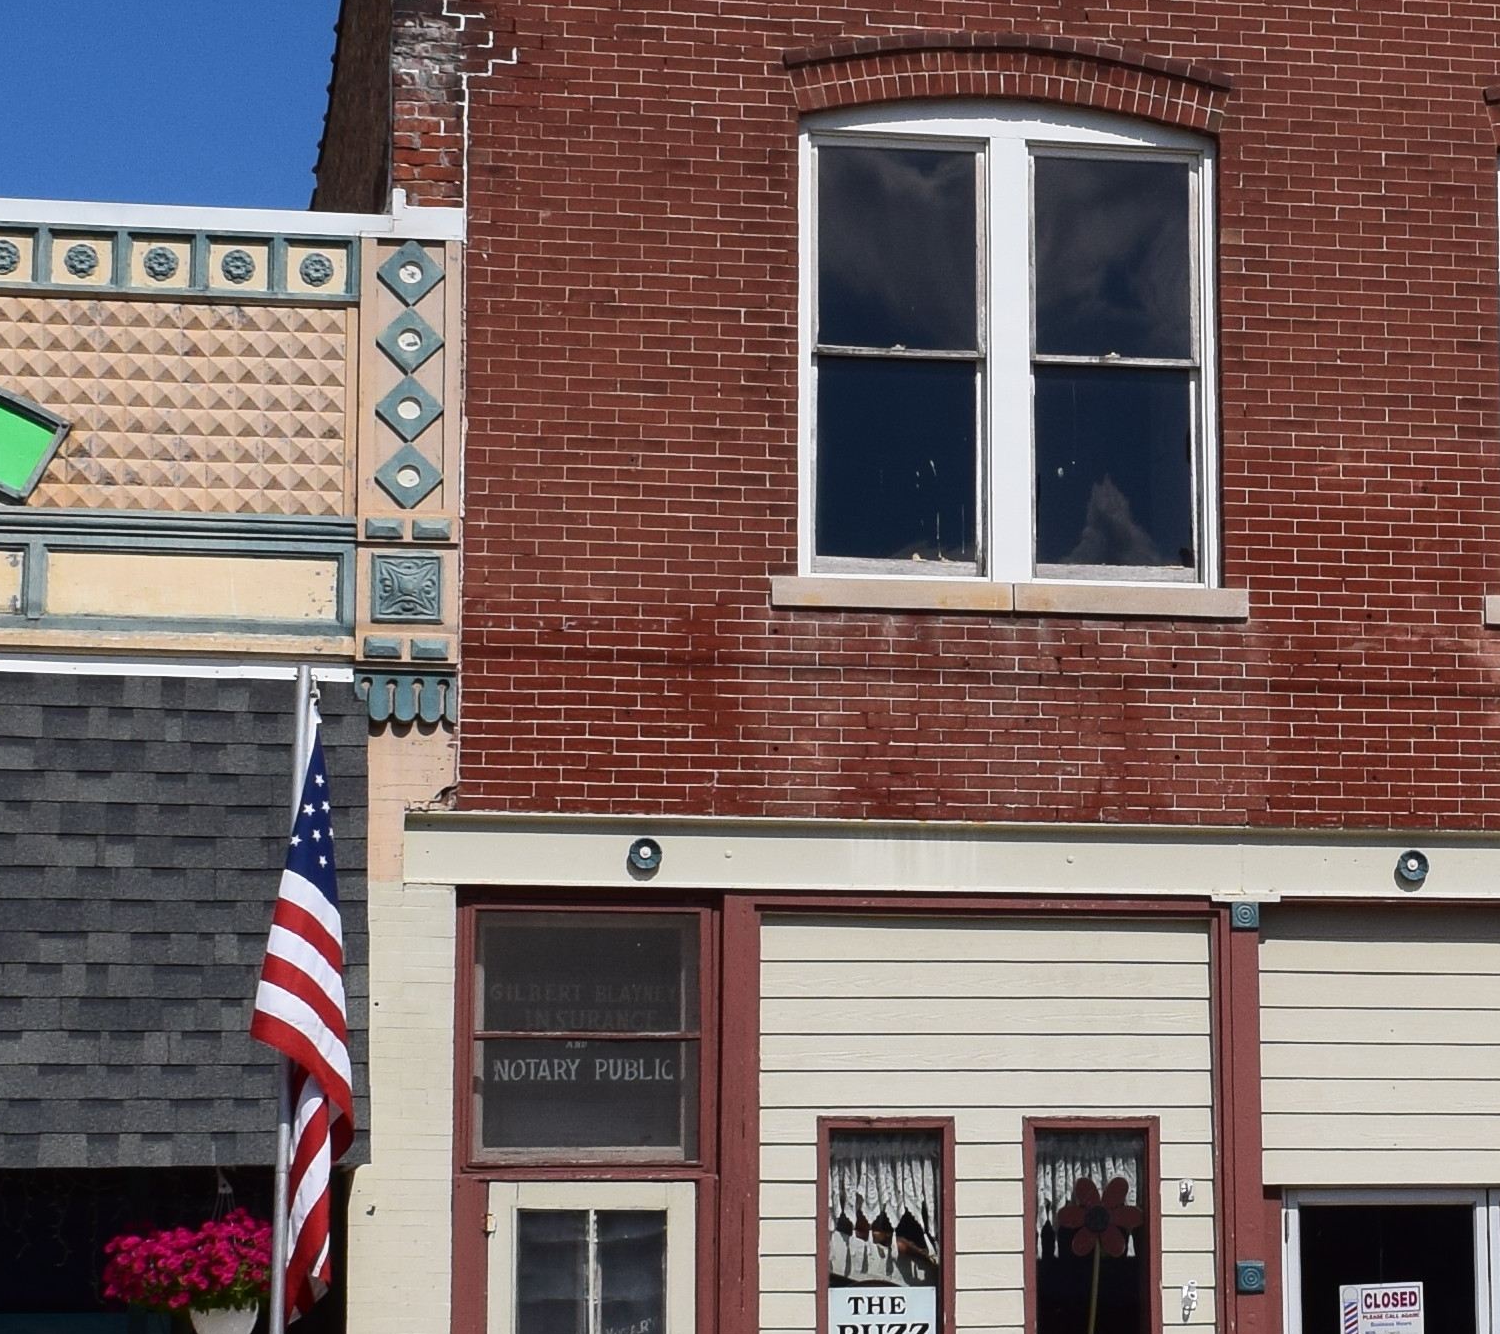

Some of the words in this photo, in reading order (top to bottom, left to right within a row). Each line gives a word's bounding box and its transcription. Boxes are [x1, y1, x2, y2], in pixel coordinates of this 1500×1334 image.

[489, 982, 581, 1003] GILBERT
[525, 1009, 659, 1030] INSURANCE
[492, 1058, 582, 1082] NOTARY
[594, 1058, 676, 1081] PUBLIC
[847, 1296, 906, 1315] THE
[1364, 1291, 1418, 1309] CLOSED
